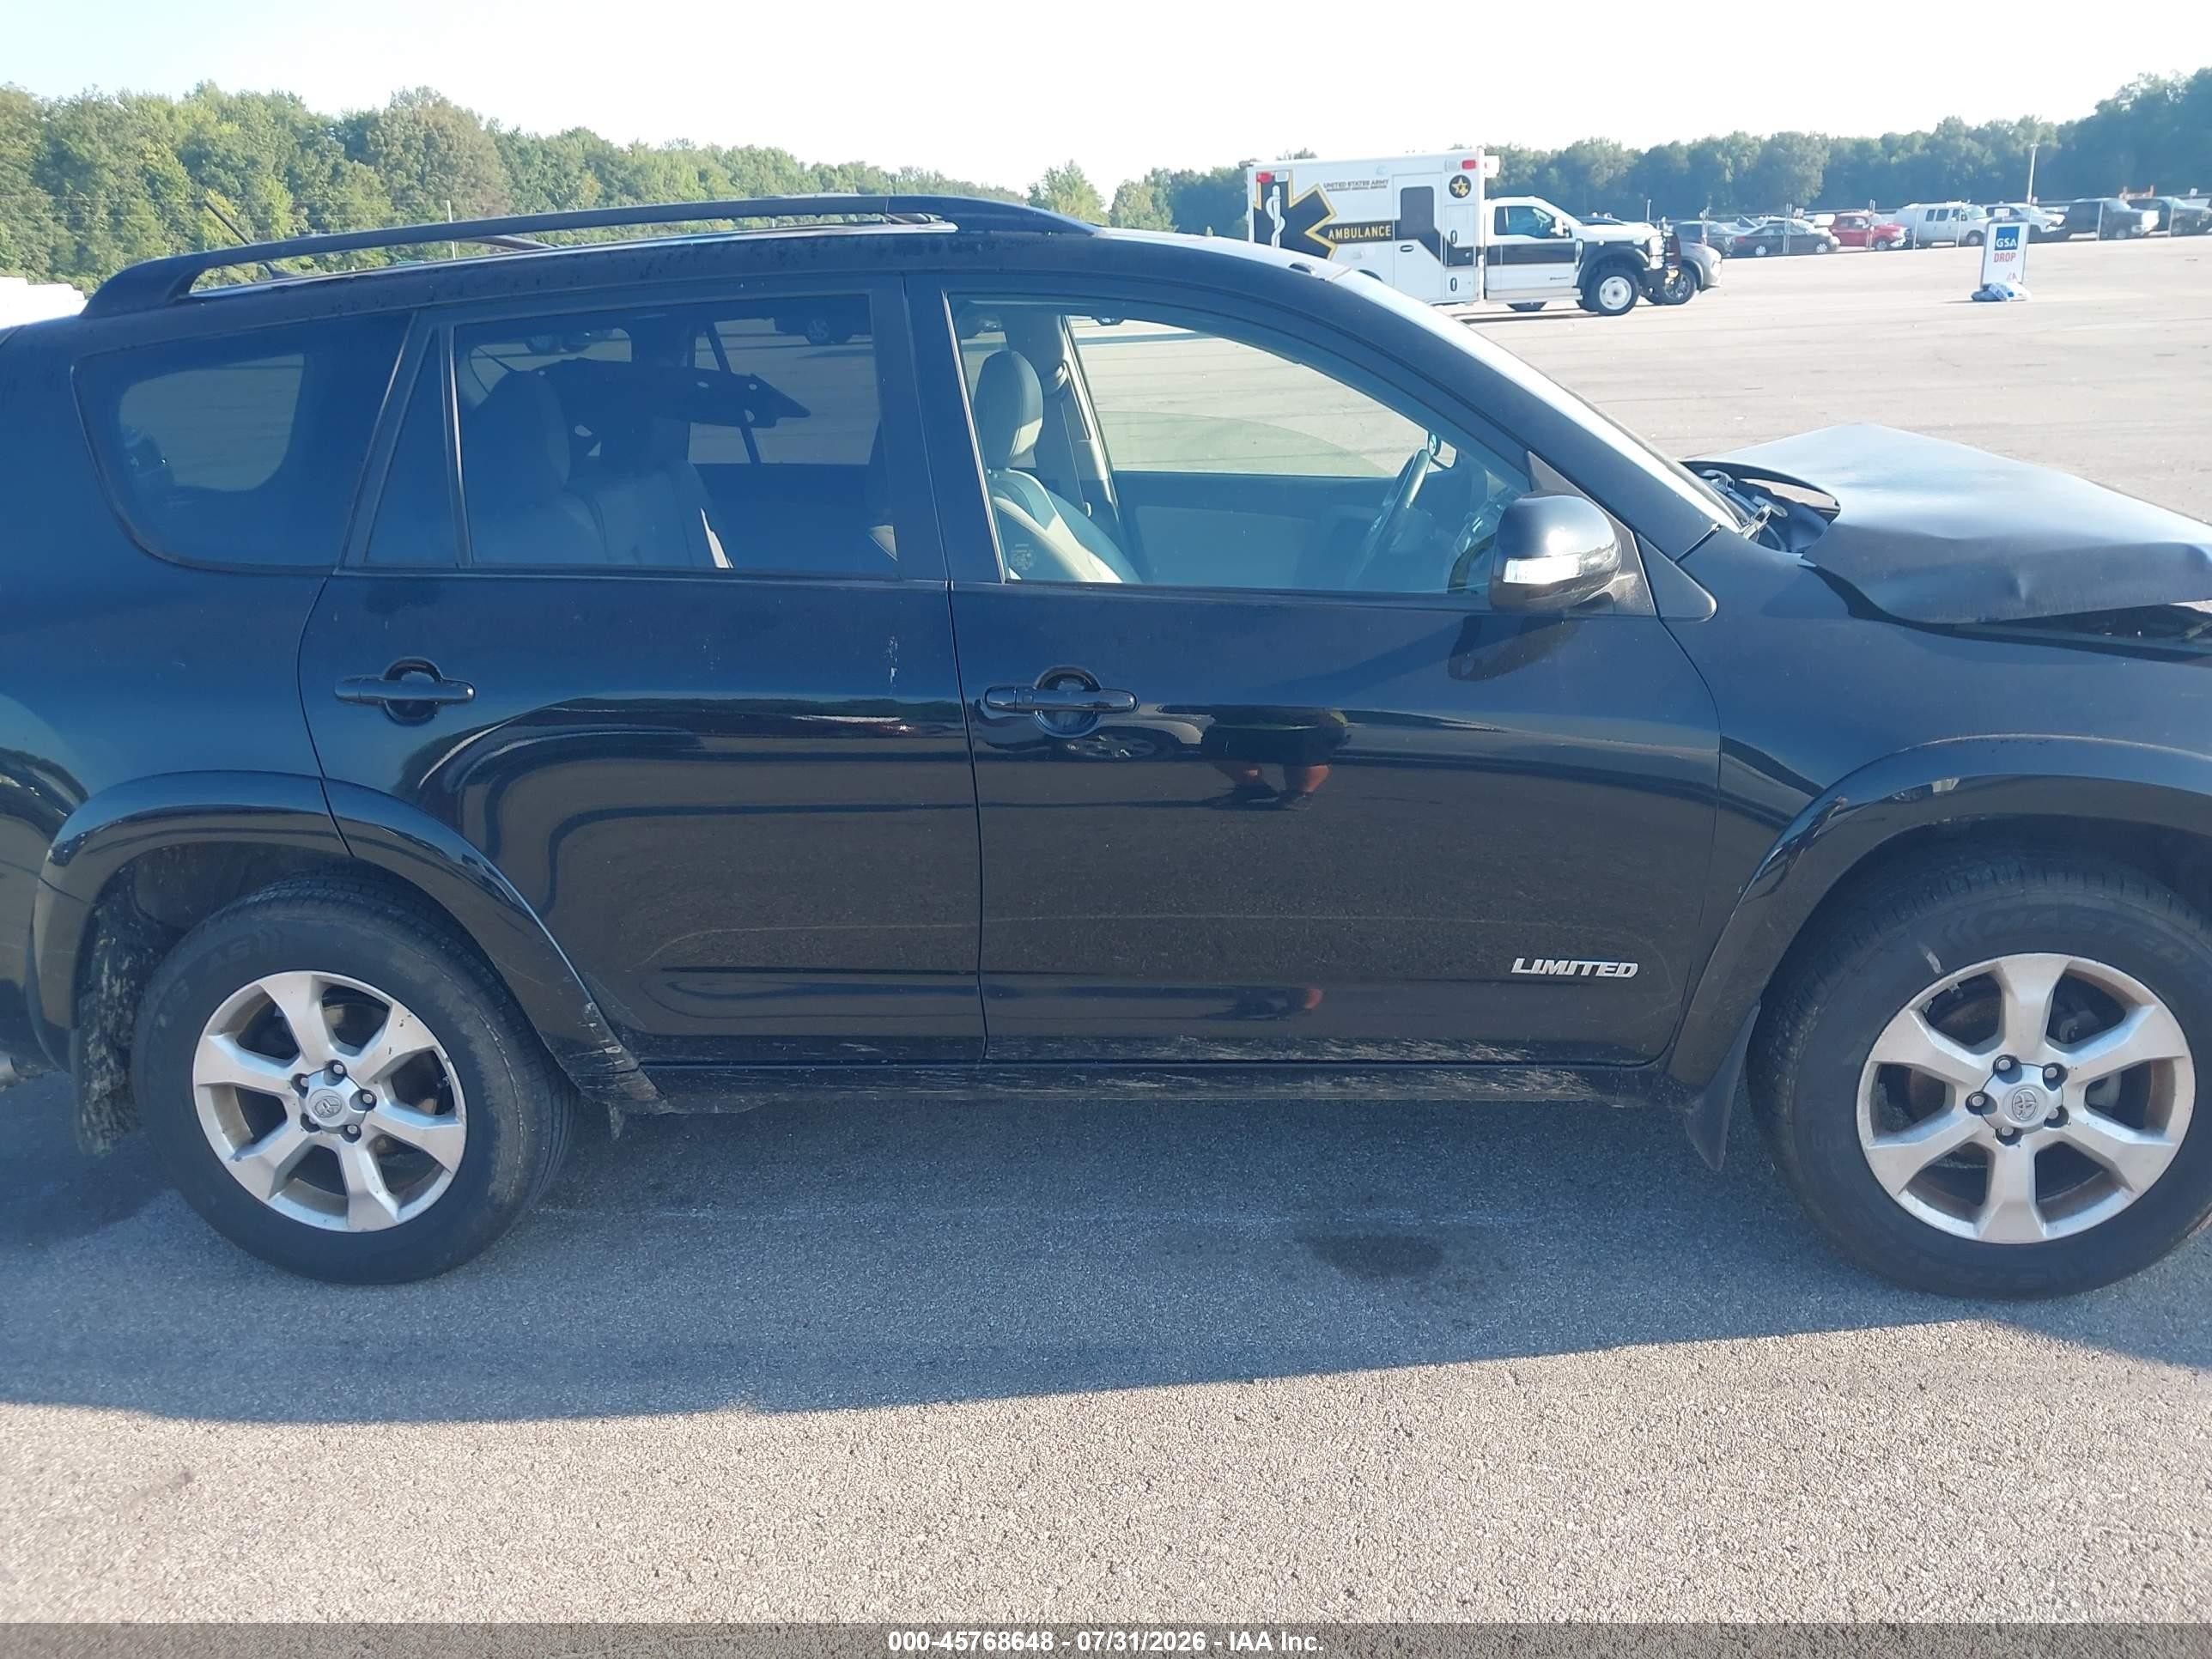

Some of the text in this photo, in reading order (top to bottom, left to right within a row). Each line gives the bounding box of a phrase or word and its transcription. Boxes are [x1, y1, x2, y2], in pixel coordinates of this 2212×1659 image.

[1328, 225, 1392, 240] AMBULANCE
[1996, 237, 2017, 248] GSA
[1993, 252, 2016, 263] DROP
[1510, 957, 1638, 978] LIMITED
